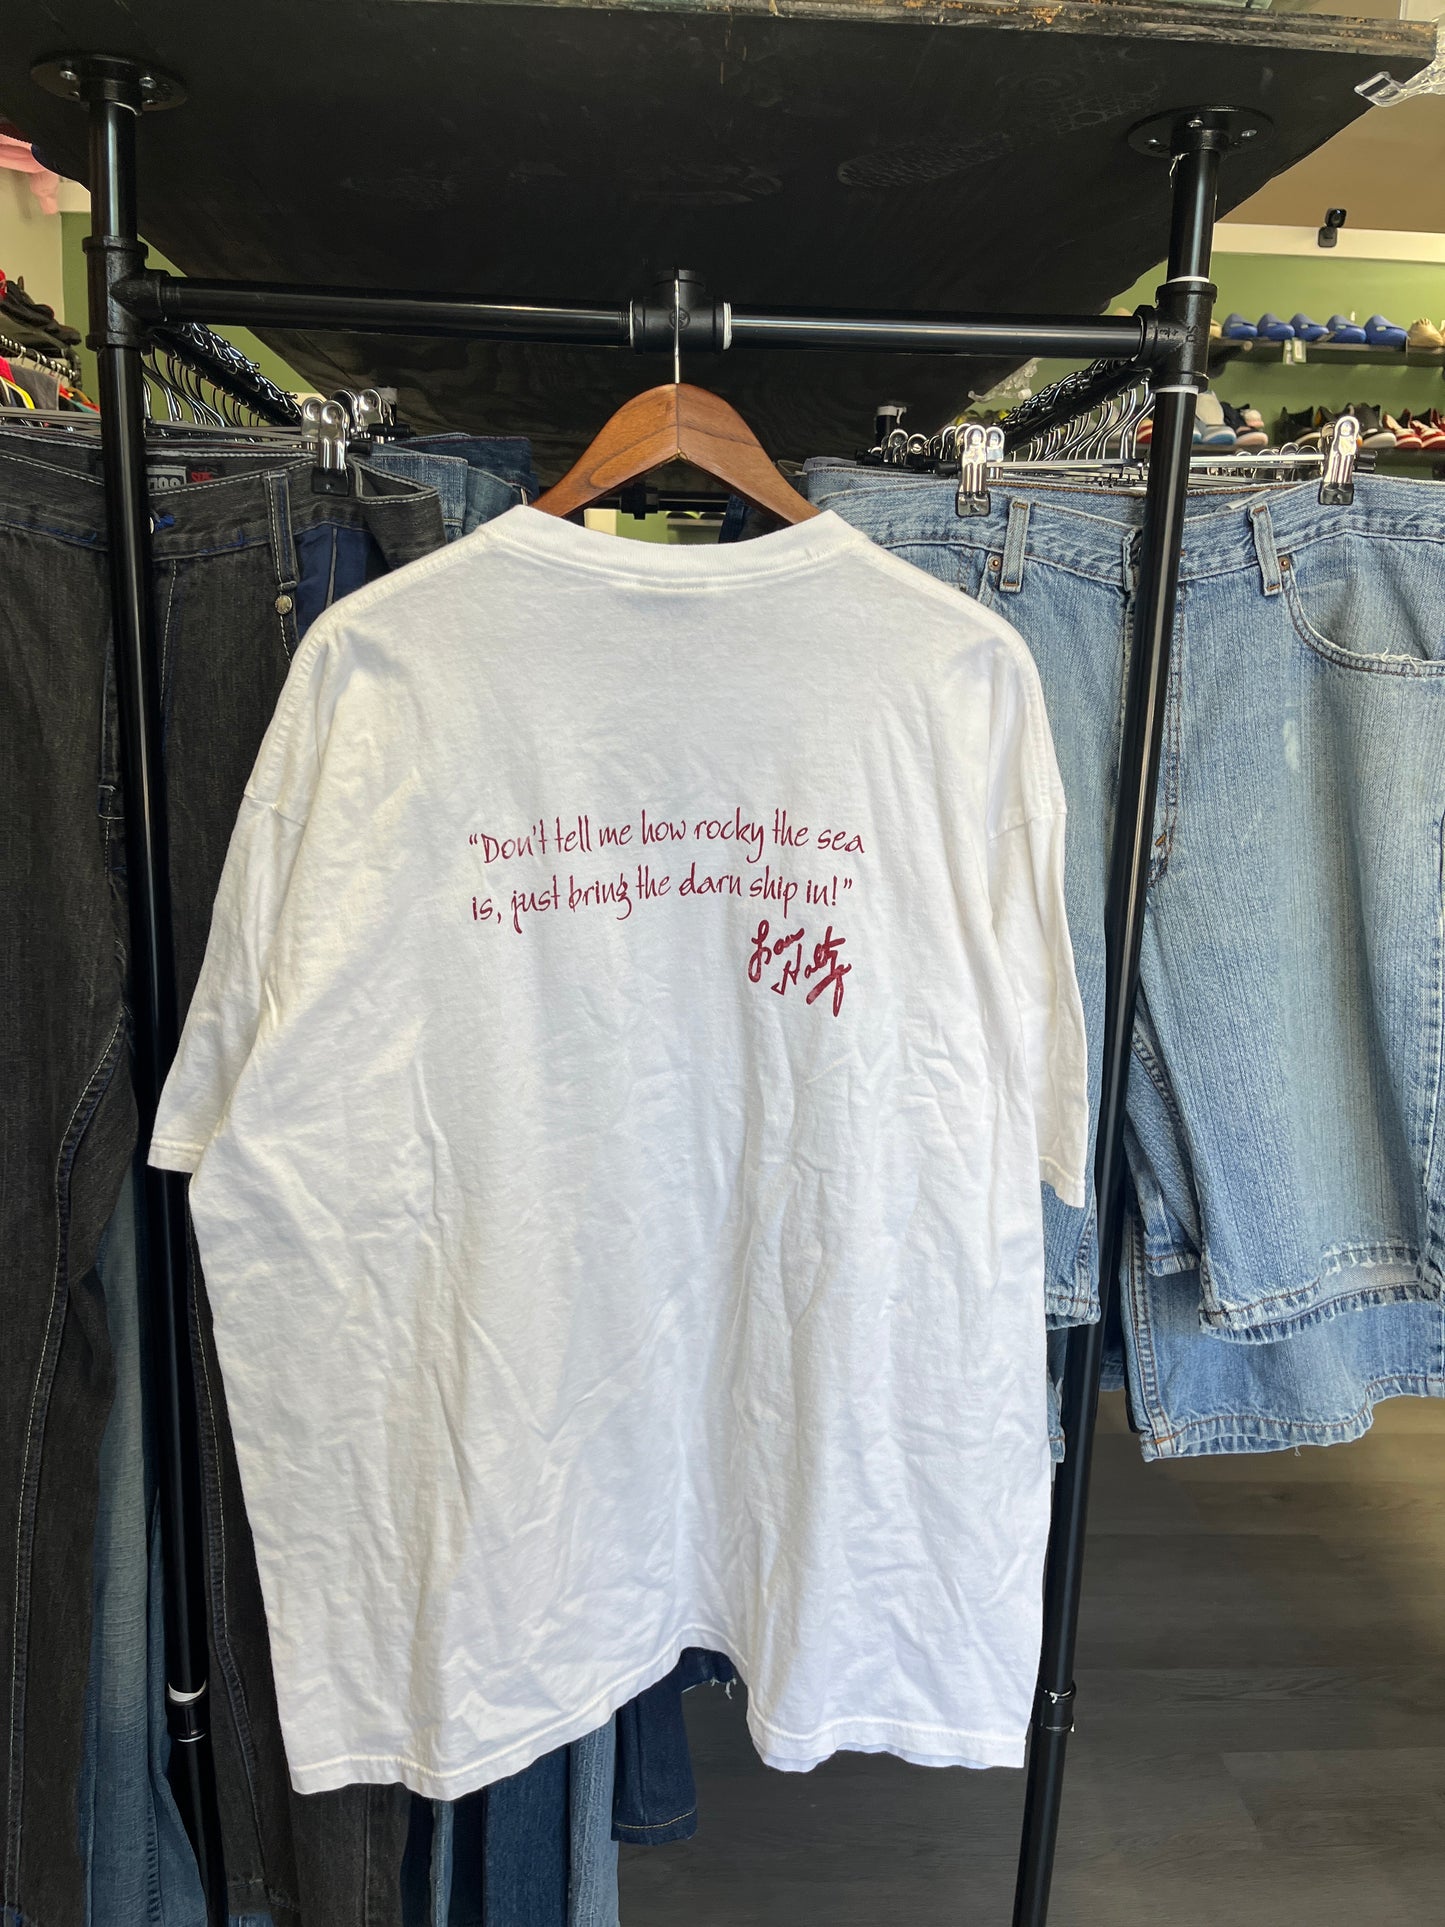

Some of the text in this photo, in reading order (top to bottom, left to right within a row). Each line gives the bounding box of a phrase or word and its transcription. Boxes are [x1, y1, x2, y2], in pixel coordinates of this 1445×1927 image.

[468, 807, 866, 865] “Don't tell me how rocky the sea
[472, 862, 853, 934] is, just bring the darn ship in!”
